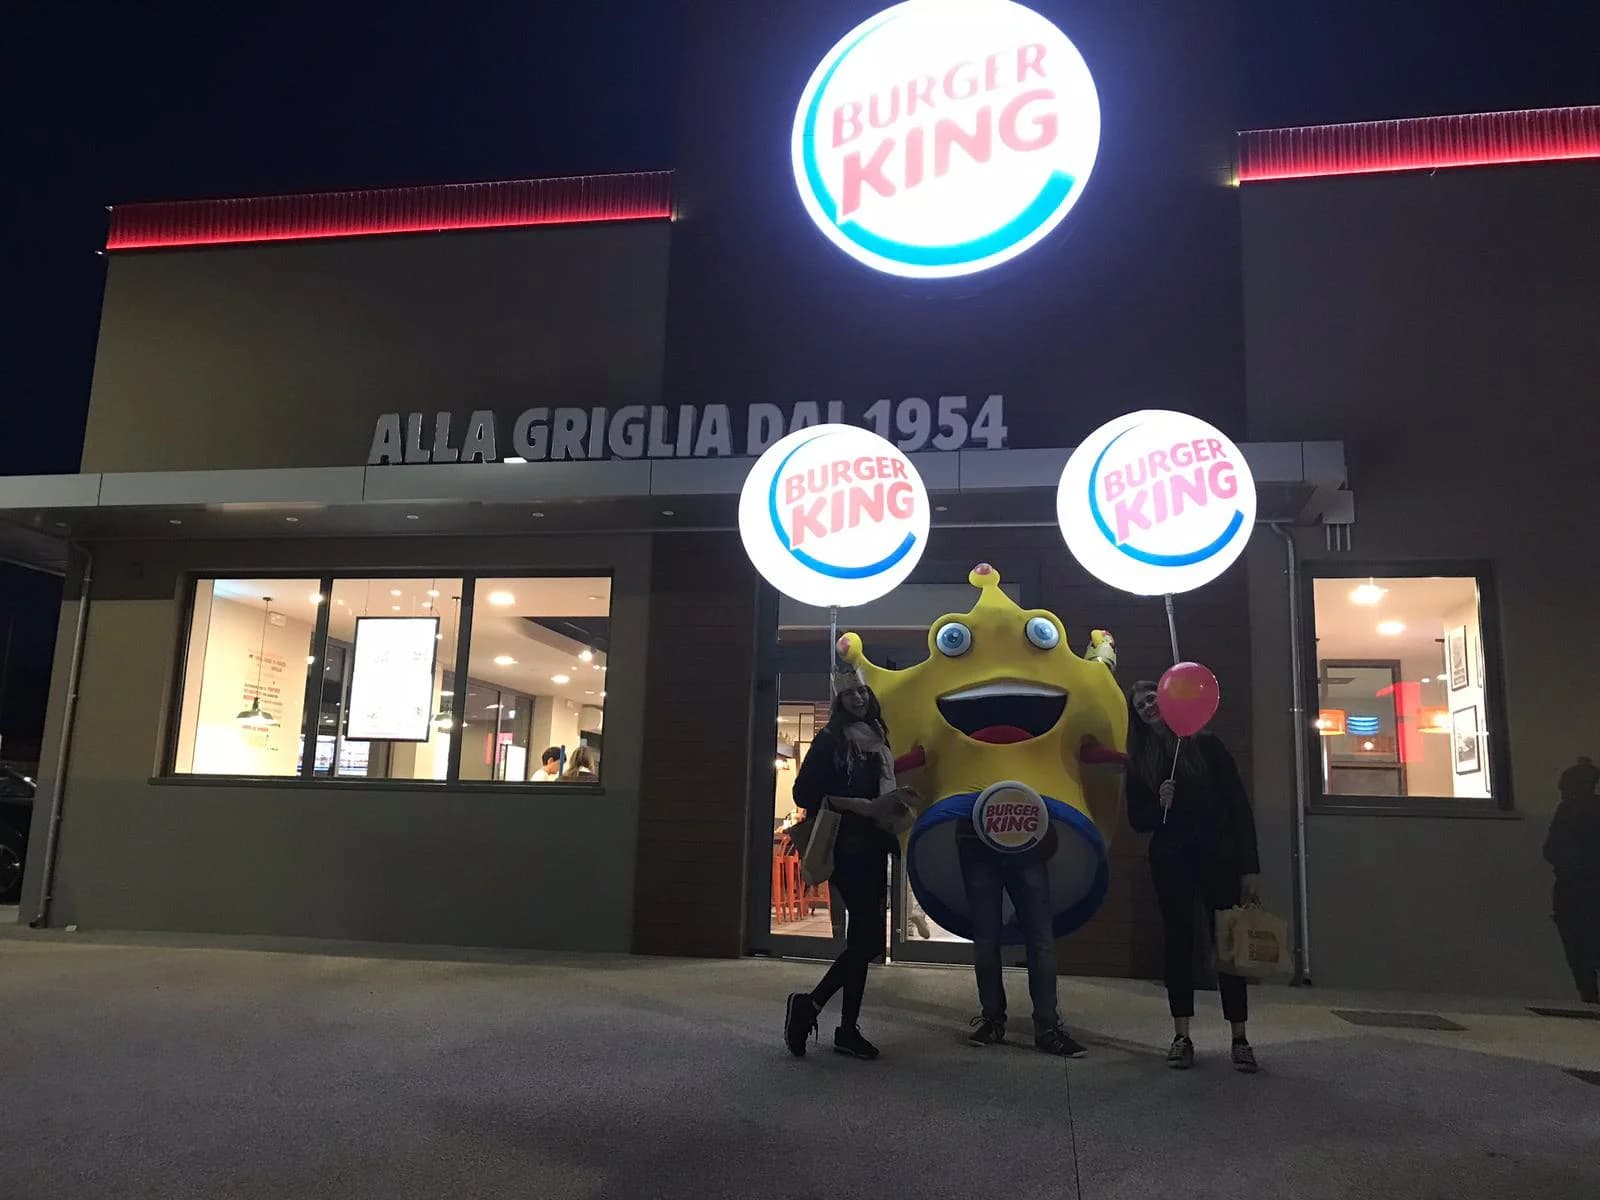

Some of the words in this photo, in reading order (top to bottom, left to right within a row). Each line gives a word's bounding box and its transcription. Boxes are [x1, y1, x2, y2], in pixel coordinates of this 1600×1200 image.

[832, 43, 1047, 149] BURGER
[842, 88, 1059, 217] KING
[367, 410, 497, 465] ALLA
[512, 404, 733, 459] GRIGLIA
[863, 395, 1008, 451] 1954
[785, 456, 908, 505] BURGER
[1104, 438, 1227, 502] BURGER
[1115, 461, 1238, 542] KING
[791, 481, 915, 547] KING
[986, 804, 1040, 817] BURGER
[986, 816, 1039, 833] KING
